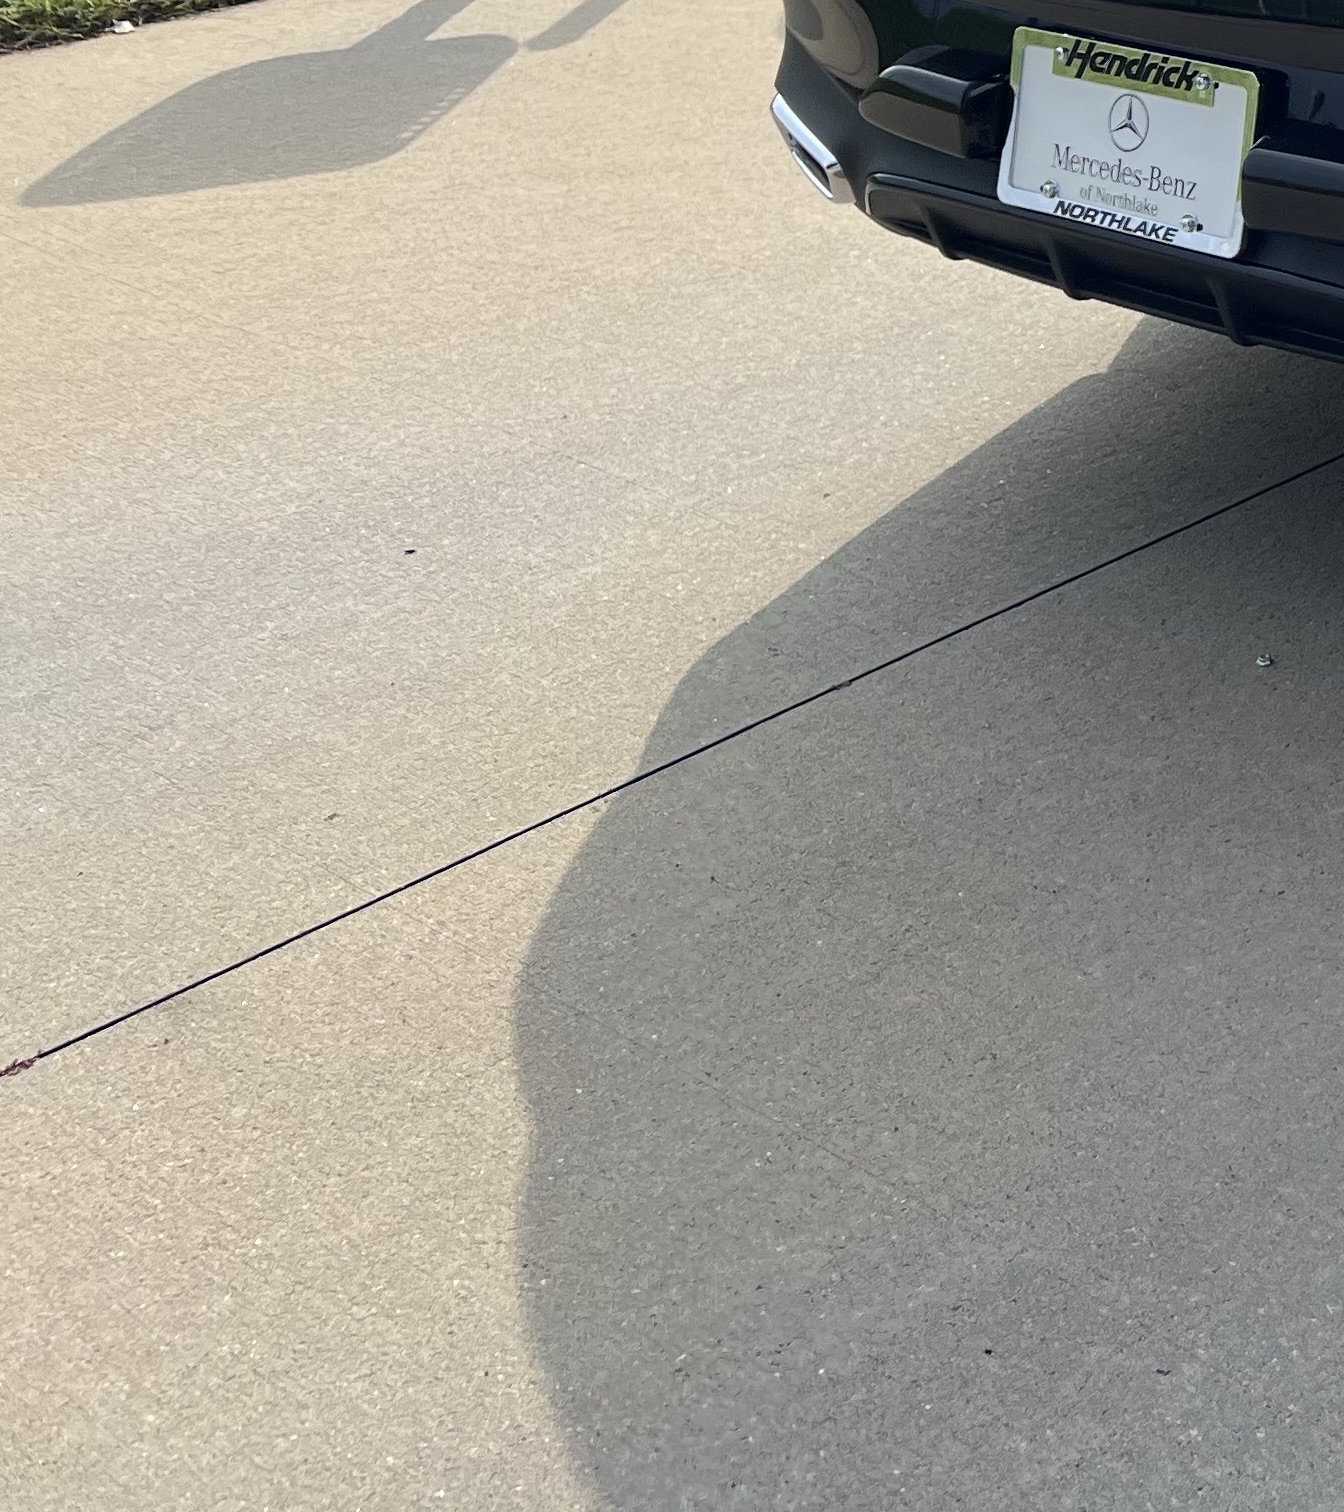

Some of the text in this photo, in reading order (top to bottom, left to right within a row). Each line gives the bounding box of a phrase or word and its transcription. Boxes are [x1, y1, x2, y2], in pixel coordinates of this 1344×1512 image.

[1065, 39, 1200, 91] Hendrick
[1050, 143, 1198, 201] Mercedes-Benz
[1052, 200, 1179, 243] NORTHLAKE
[1079, 185, 1159, 217] of Northlake
